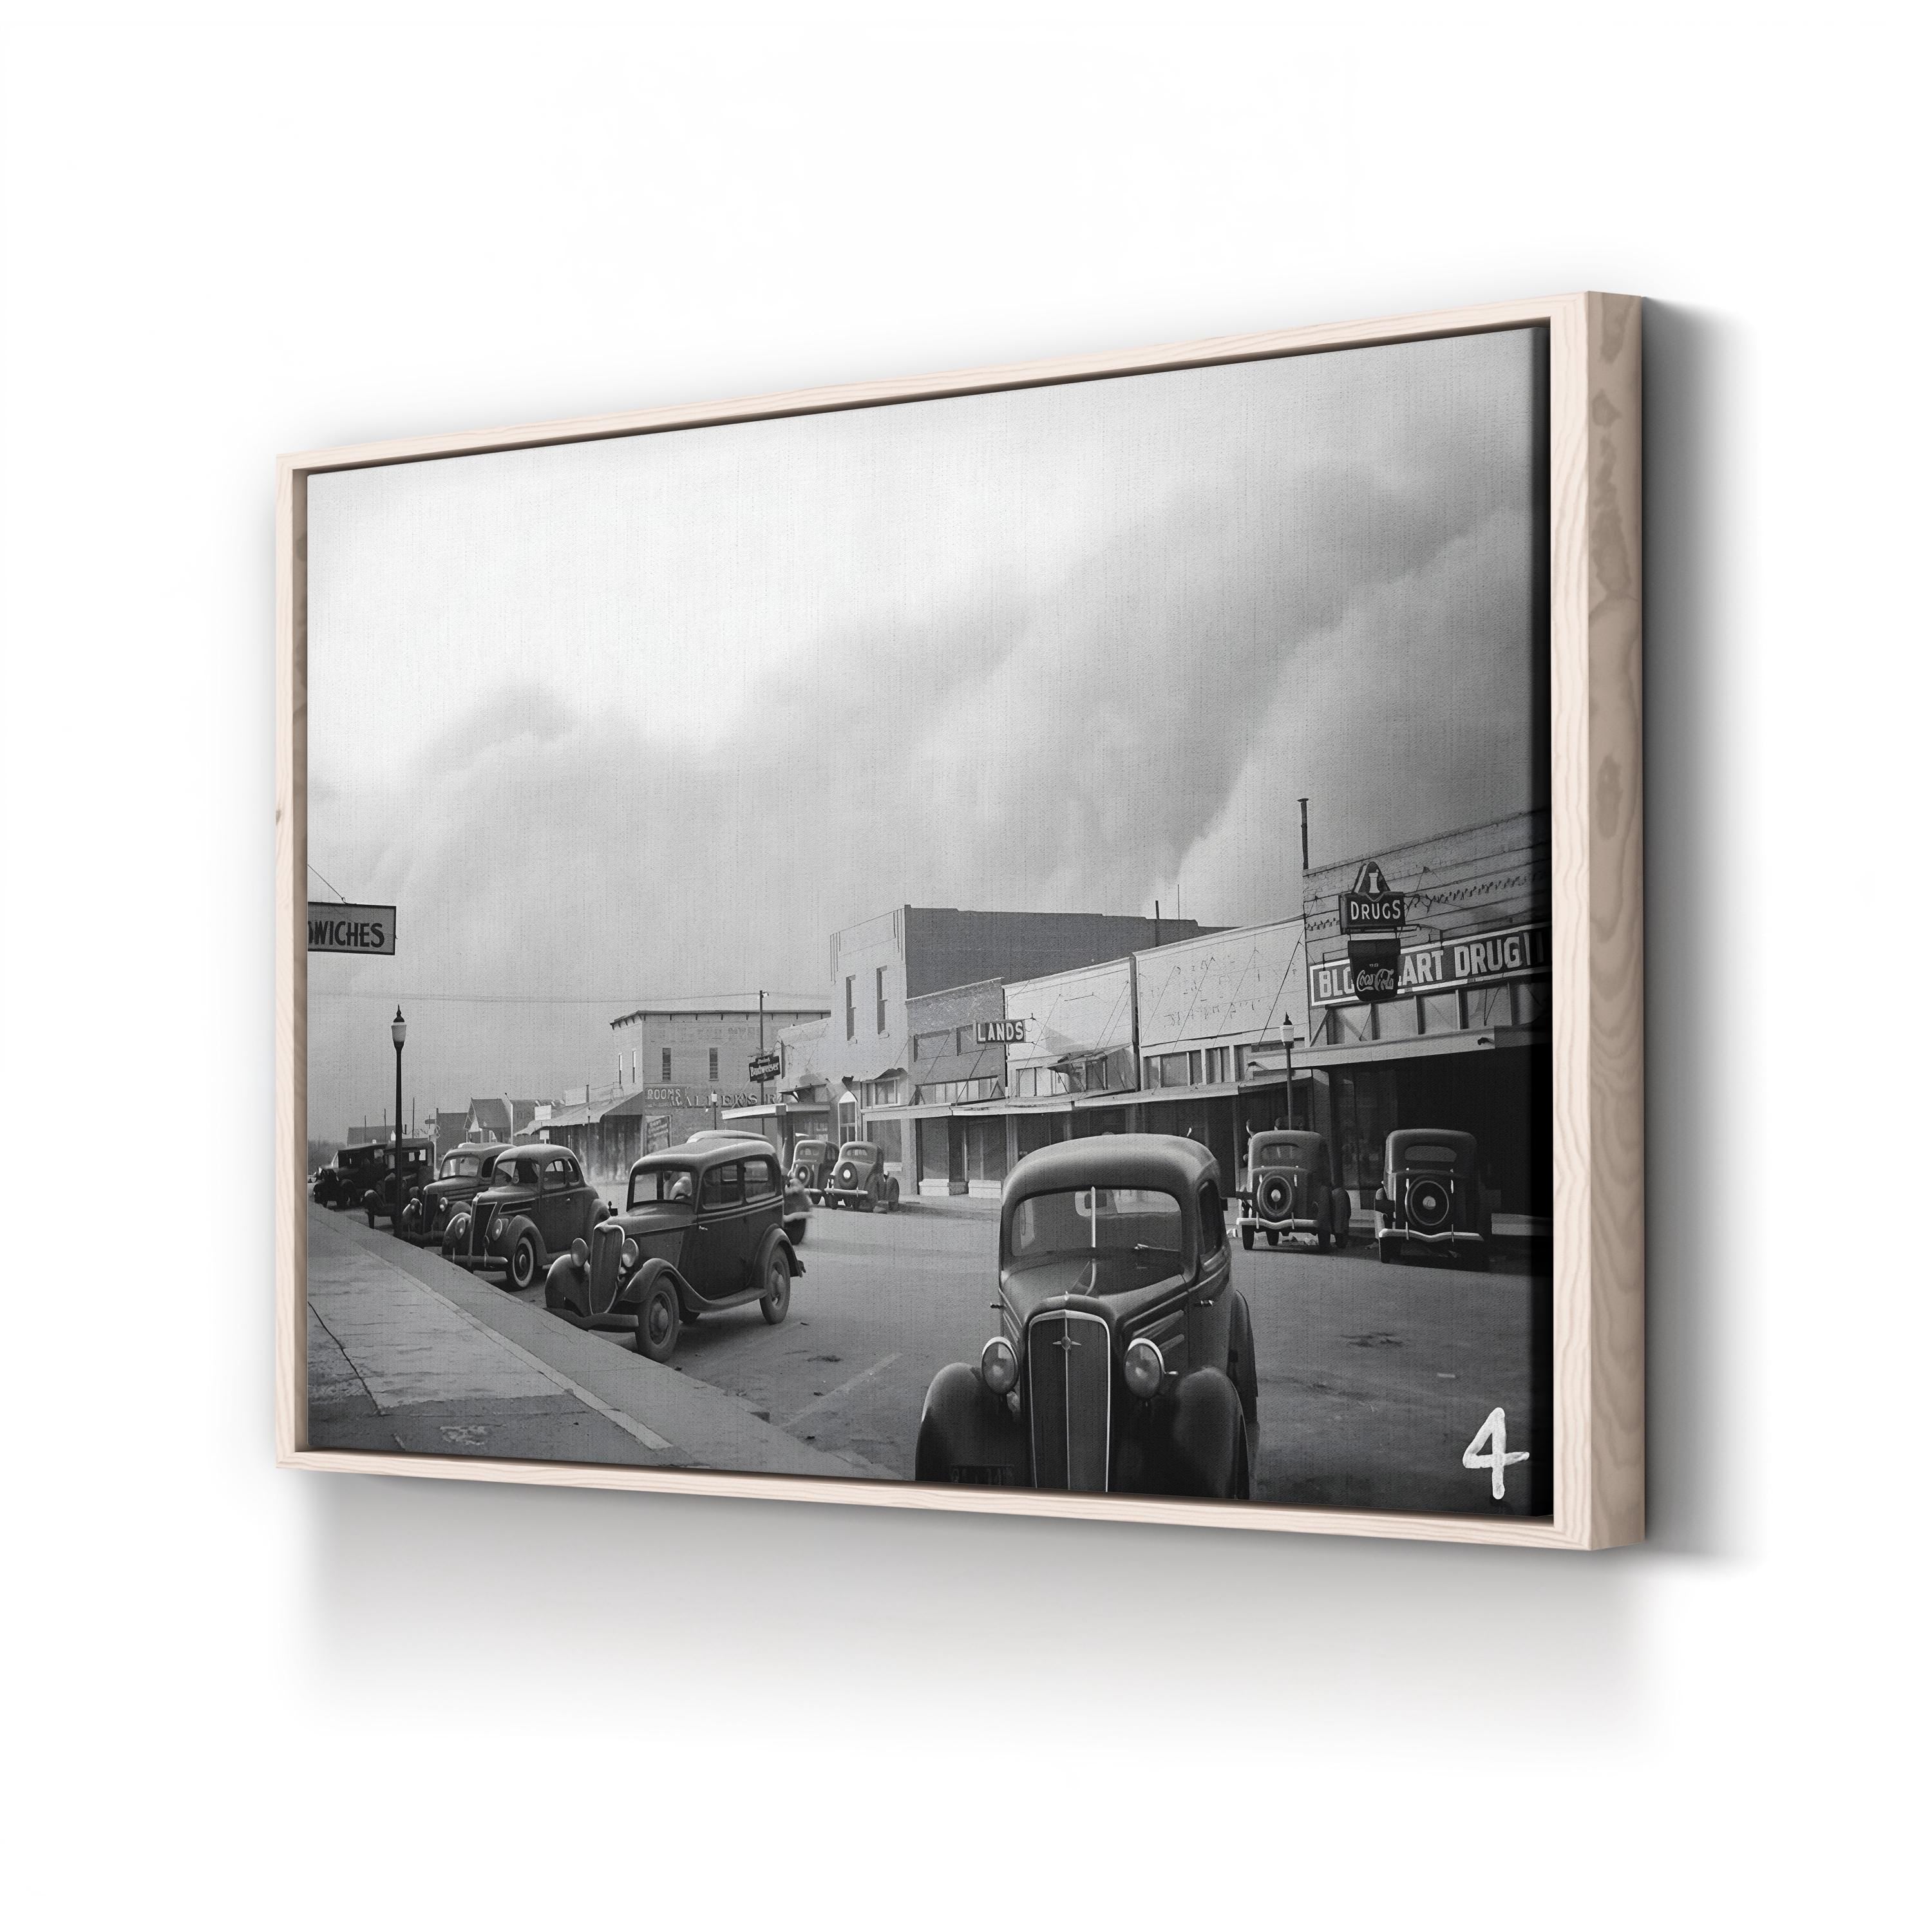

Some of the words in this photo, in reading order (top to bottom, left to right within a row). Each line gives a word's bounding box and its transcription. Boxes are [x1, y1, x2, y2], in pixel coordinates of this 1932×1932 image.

[1350, 900, 1401, 920] DRUGS
[1397, 950, 1444, 987] ART
[977, 1021, 1025, 1041] LANDS
[647, 1088, 681, 1100] ROOMS
[1463, 1407, 1530, 1499] 4
